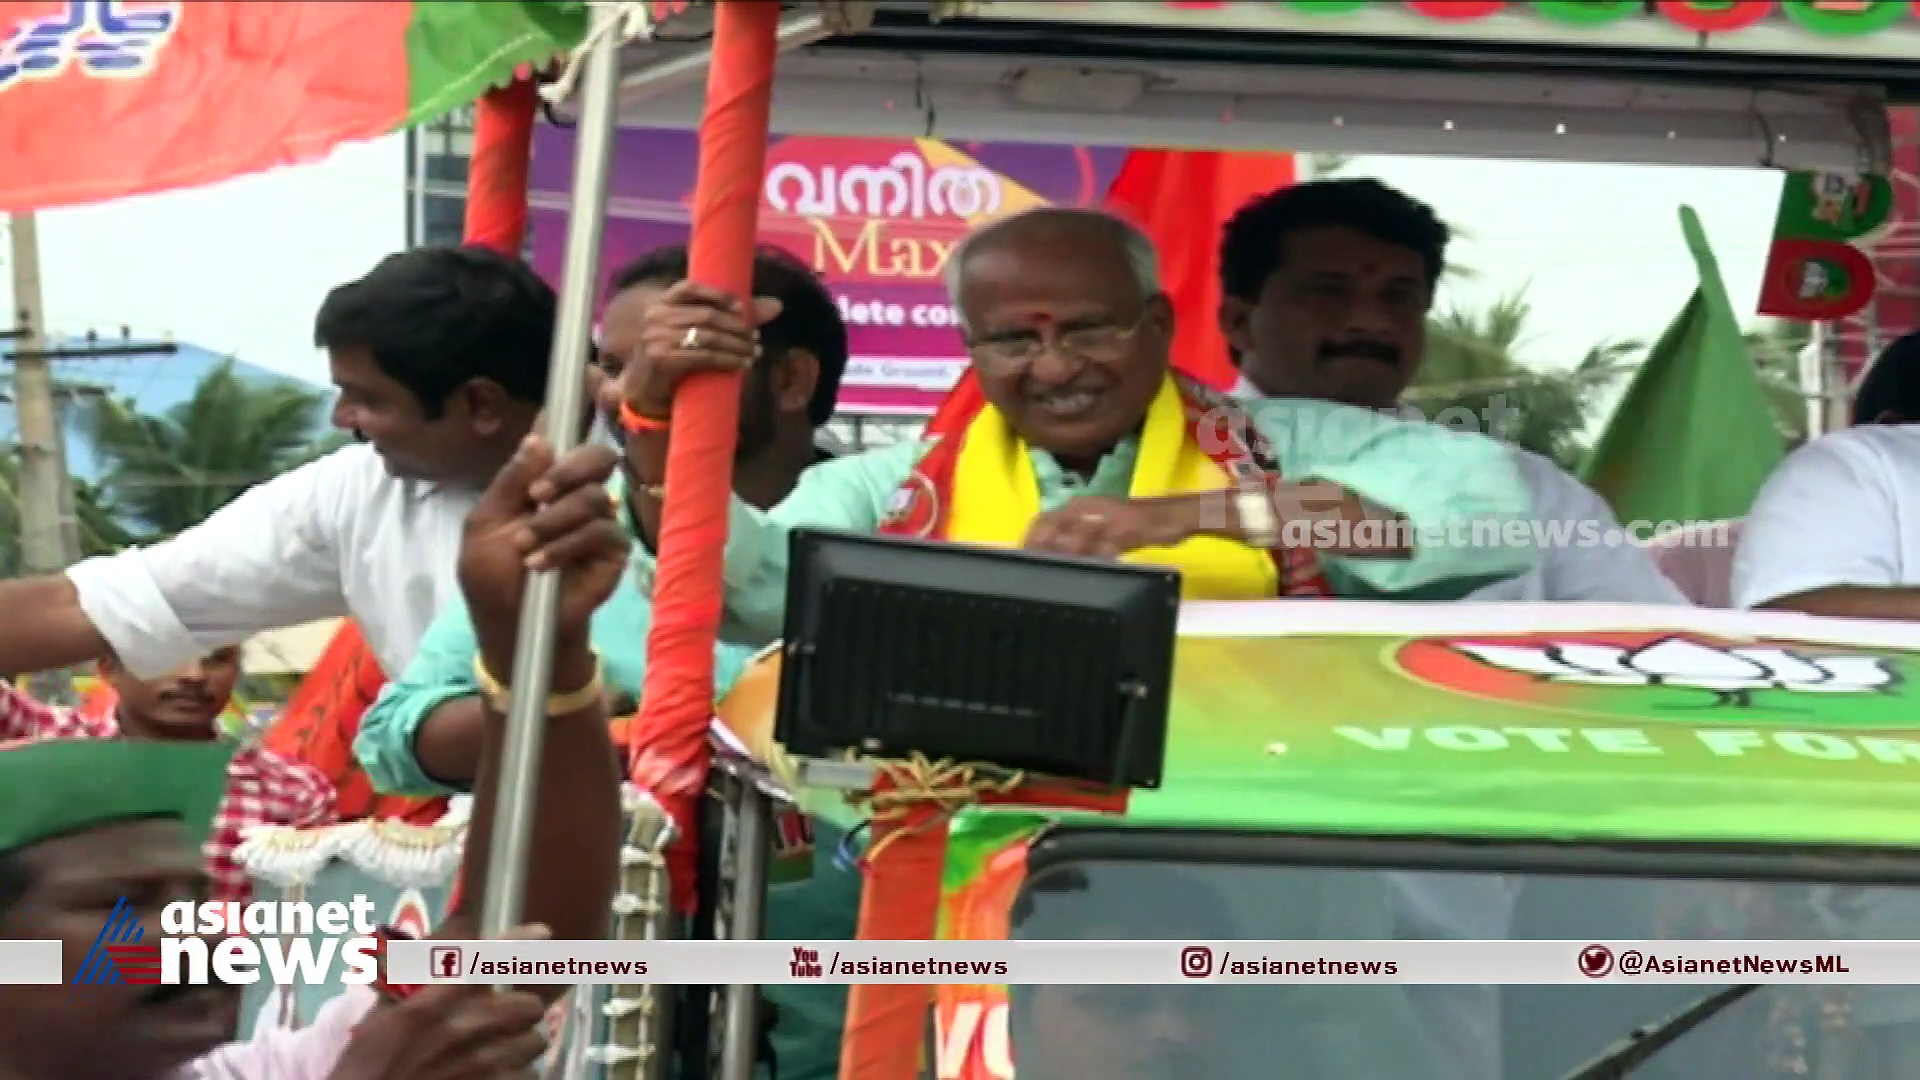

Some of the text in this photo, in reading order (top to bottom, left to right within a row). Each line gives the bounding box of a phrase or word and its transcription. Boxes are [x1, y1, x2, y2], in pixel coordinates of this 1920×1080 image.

[765, 152, 1001, 218] വനിത
[837, 294, 905, 326] lete
[1333, 725, 1664, 756] VOTE
